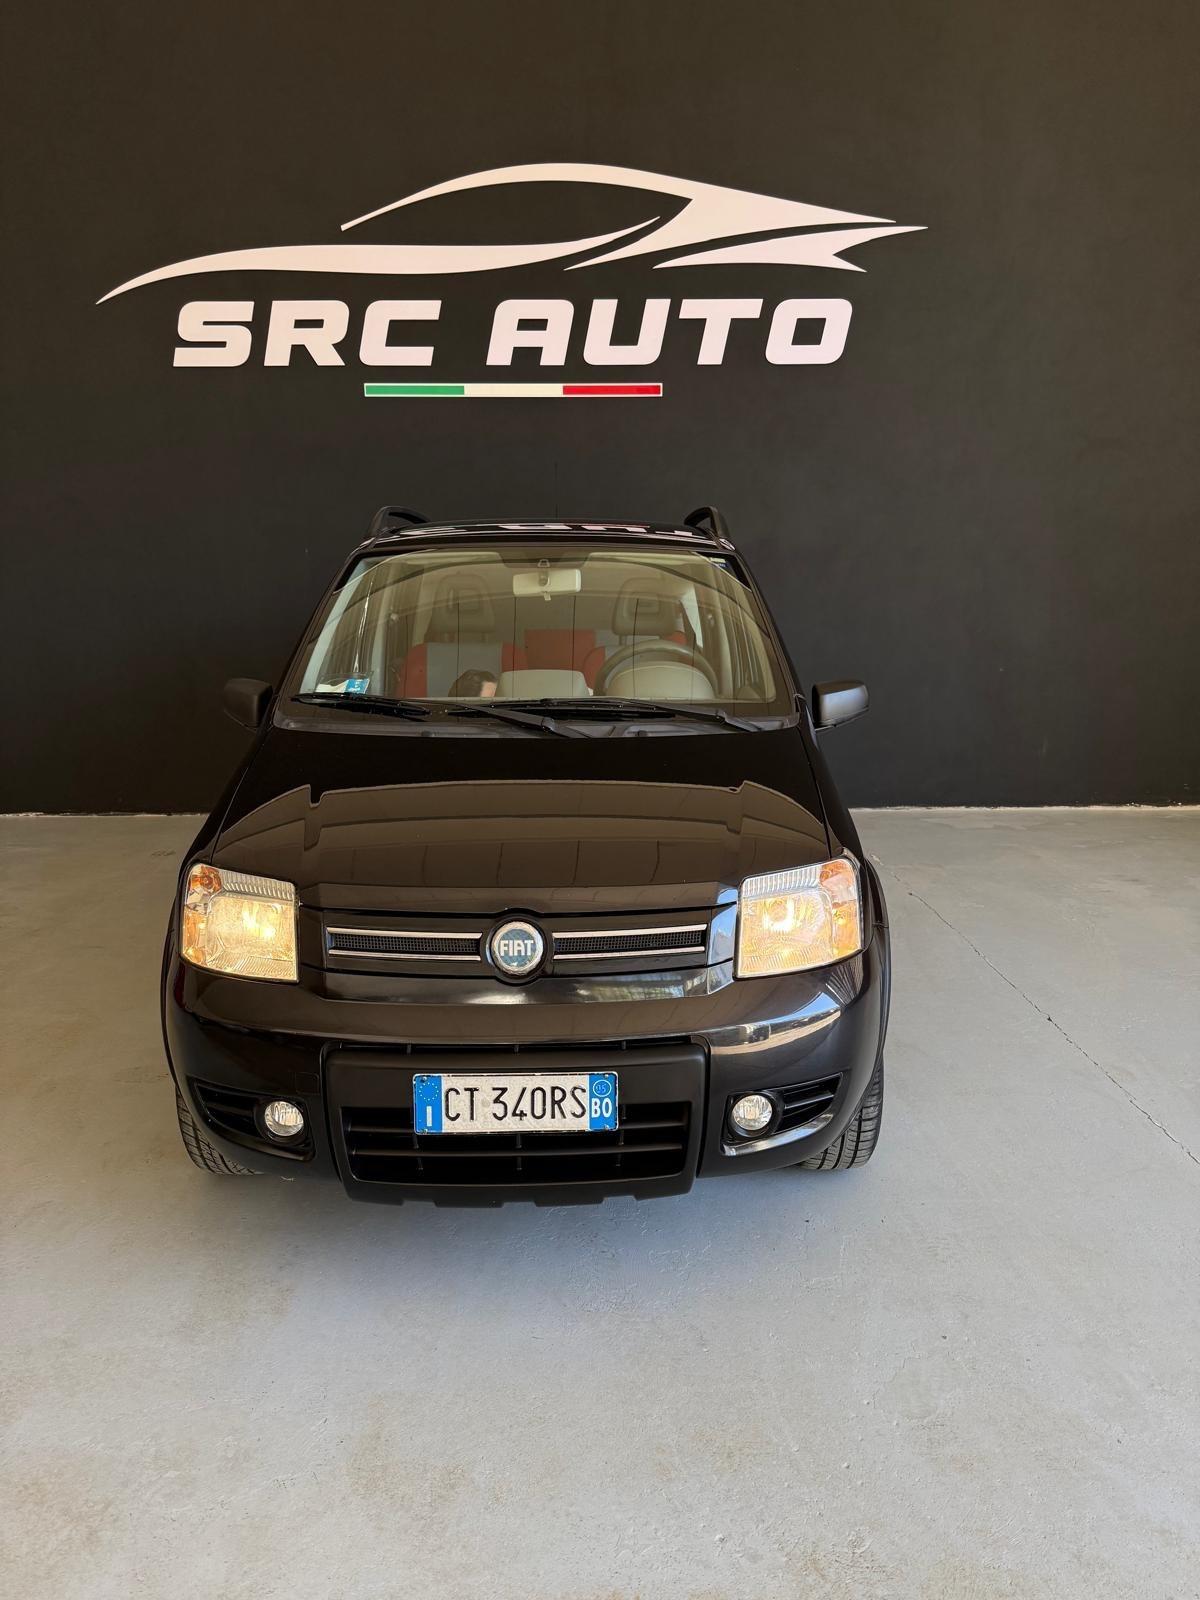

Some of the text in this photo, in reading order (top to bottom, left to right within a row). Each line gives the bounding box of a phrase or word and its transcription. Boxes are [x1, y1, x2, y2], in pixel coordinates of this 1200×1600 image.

[173, 298, 853, 367] SRC AUTO
[500, 939, 534, 957] FIAT
[444, 1086, 587, 1121] CT 340RS
[591, 1097, 613, 1119] BO
